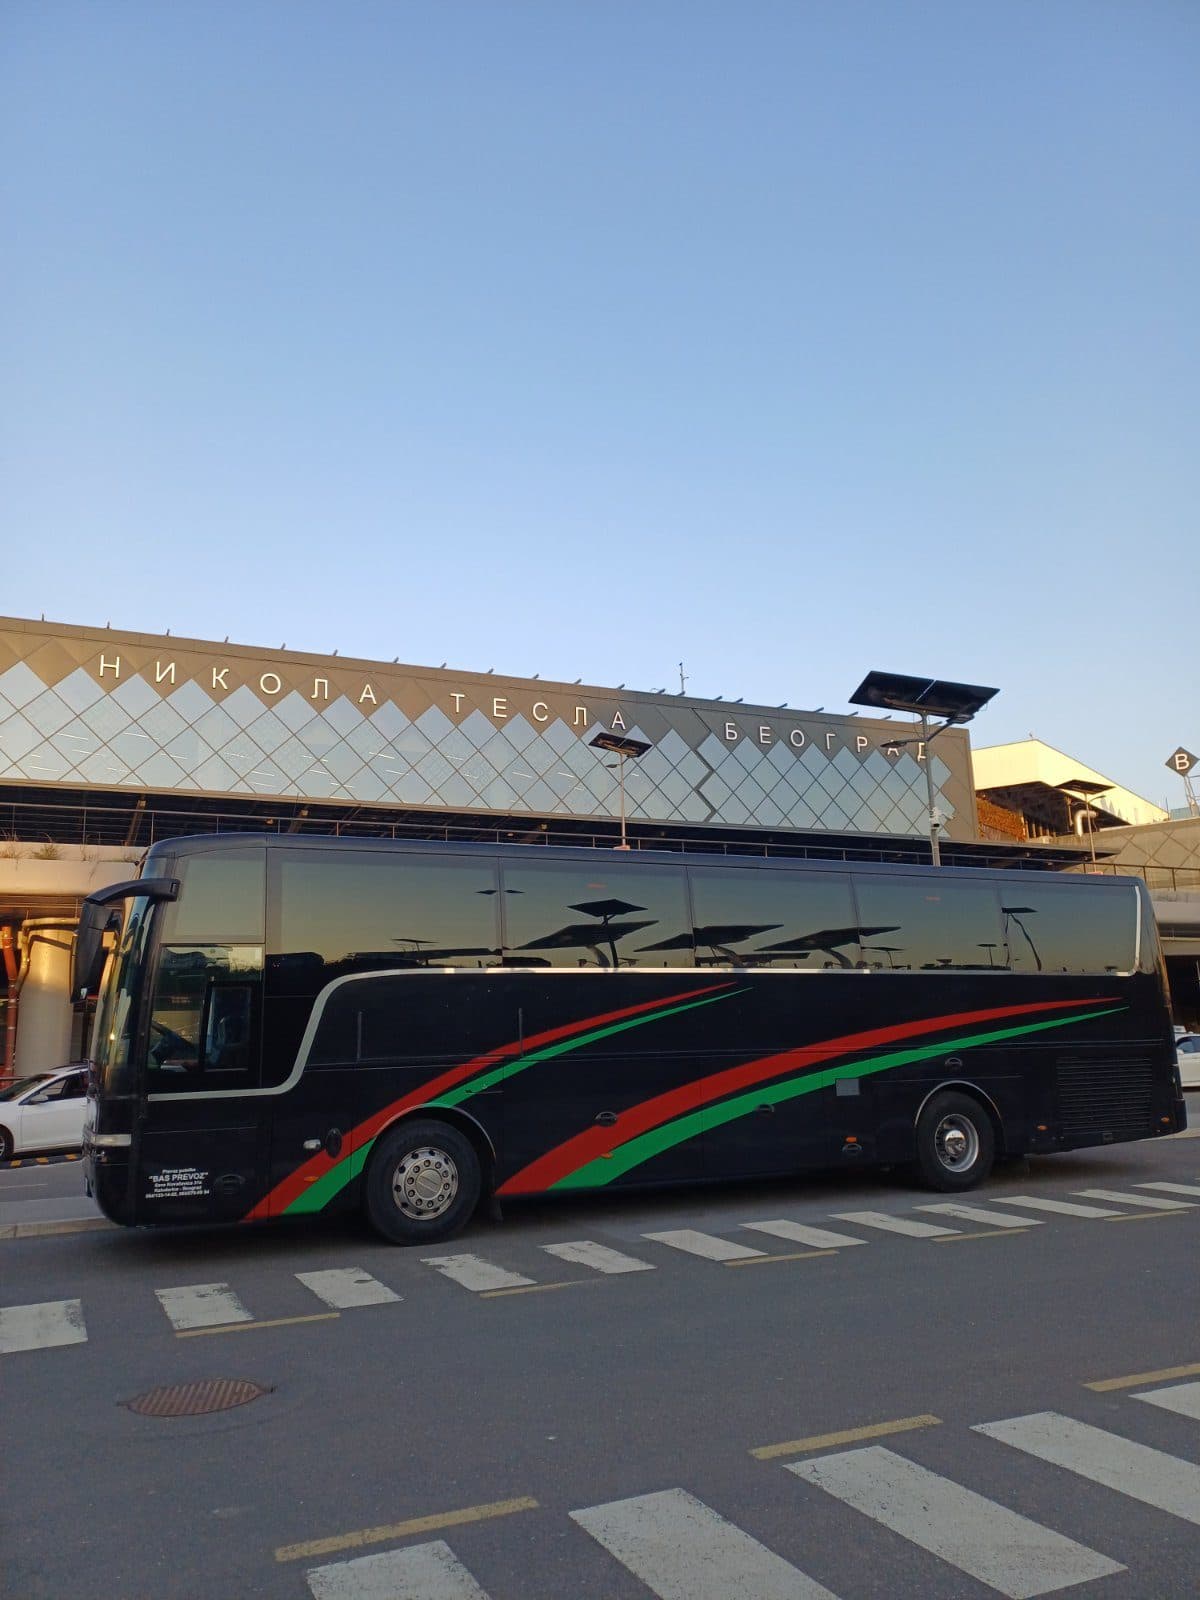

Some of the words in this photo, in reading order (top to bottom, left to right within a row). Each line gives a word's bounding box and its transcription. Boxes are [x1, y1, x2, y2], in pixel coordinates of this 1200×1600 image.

[99, 654, 378, 705] НИКОЛА
[450, 693, 627, 730] ТЕСЛА
[1174, 753, 1190, 770] B
